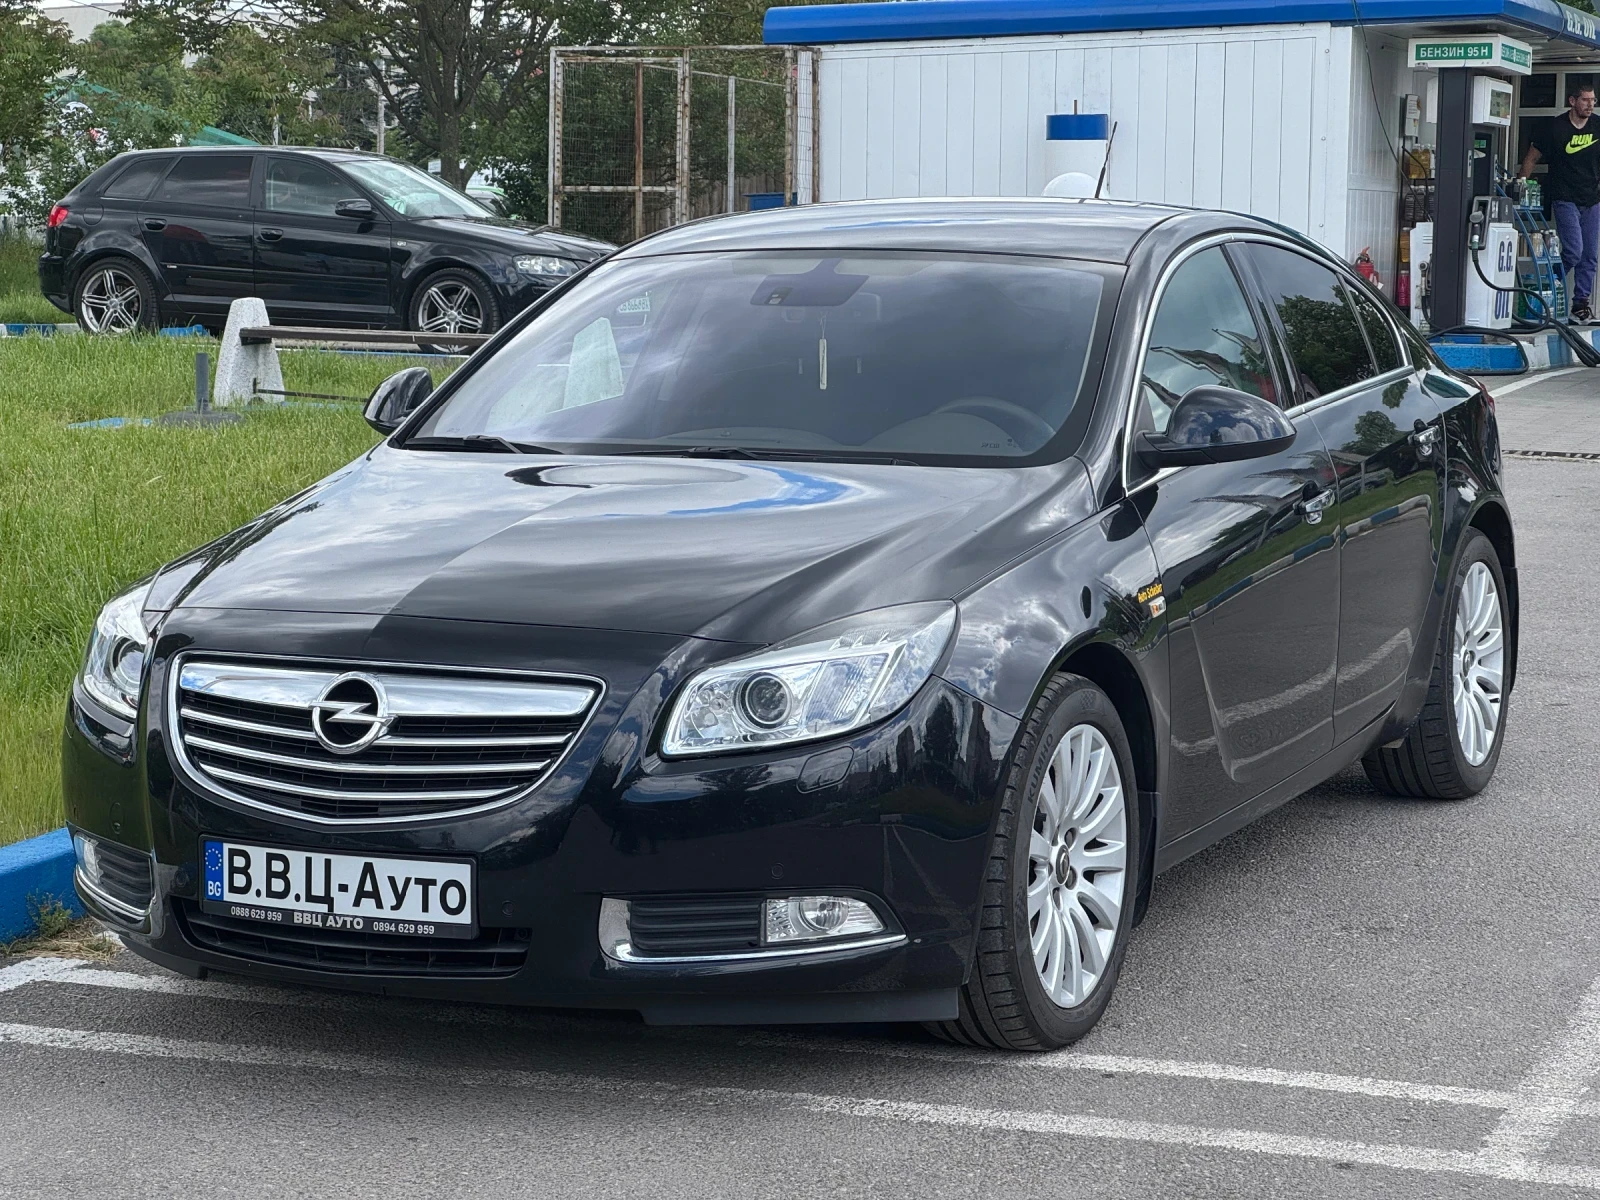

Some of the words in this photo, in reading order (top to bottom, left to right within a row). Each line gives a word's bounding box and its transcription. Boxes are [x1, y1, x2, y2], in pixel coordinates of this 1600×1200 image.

[1565, 10, 1582, 35] G.G.
[1583, 16, 1596, 40] OIL
[1420, 46, 1464, 58] БЕНЗИН
[1571, 133, 1593, 146] RUN
[1498, 240, 1513, 272] G.G.
[1494, 290, 1509, 320] OIL
[1027, 733, 1053, 804] KUMHO
[207, 880, 222, 897] BG
[227, 847, 467, 916] В.В.Ц-Ауто
[230, 906, 250, 917] 0888
[250, 908, 266, 920] 629
[267, 911, 282, 921] 959
[293, 911, 323, 928] ВВЦ
[326, 915, 364, 930] АУТО
[373, 921, 396, 932] 0894
[398, 923, 415, 934] 629
[417, 924, 435, 935] 959
